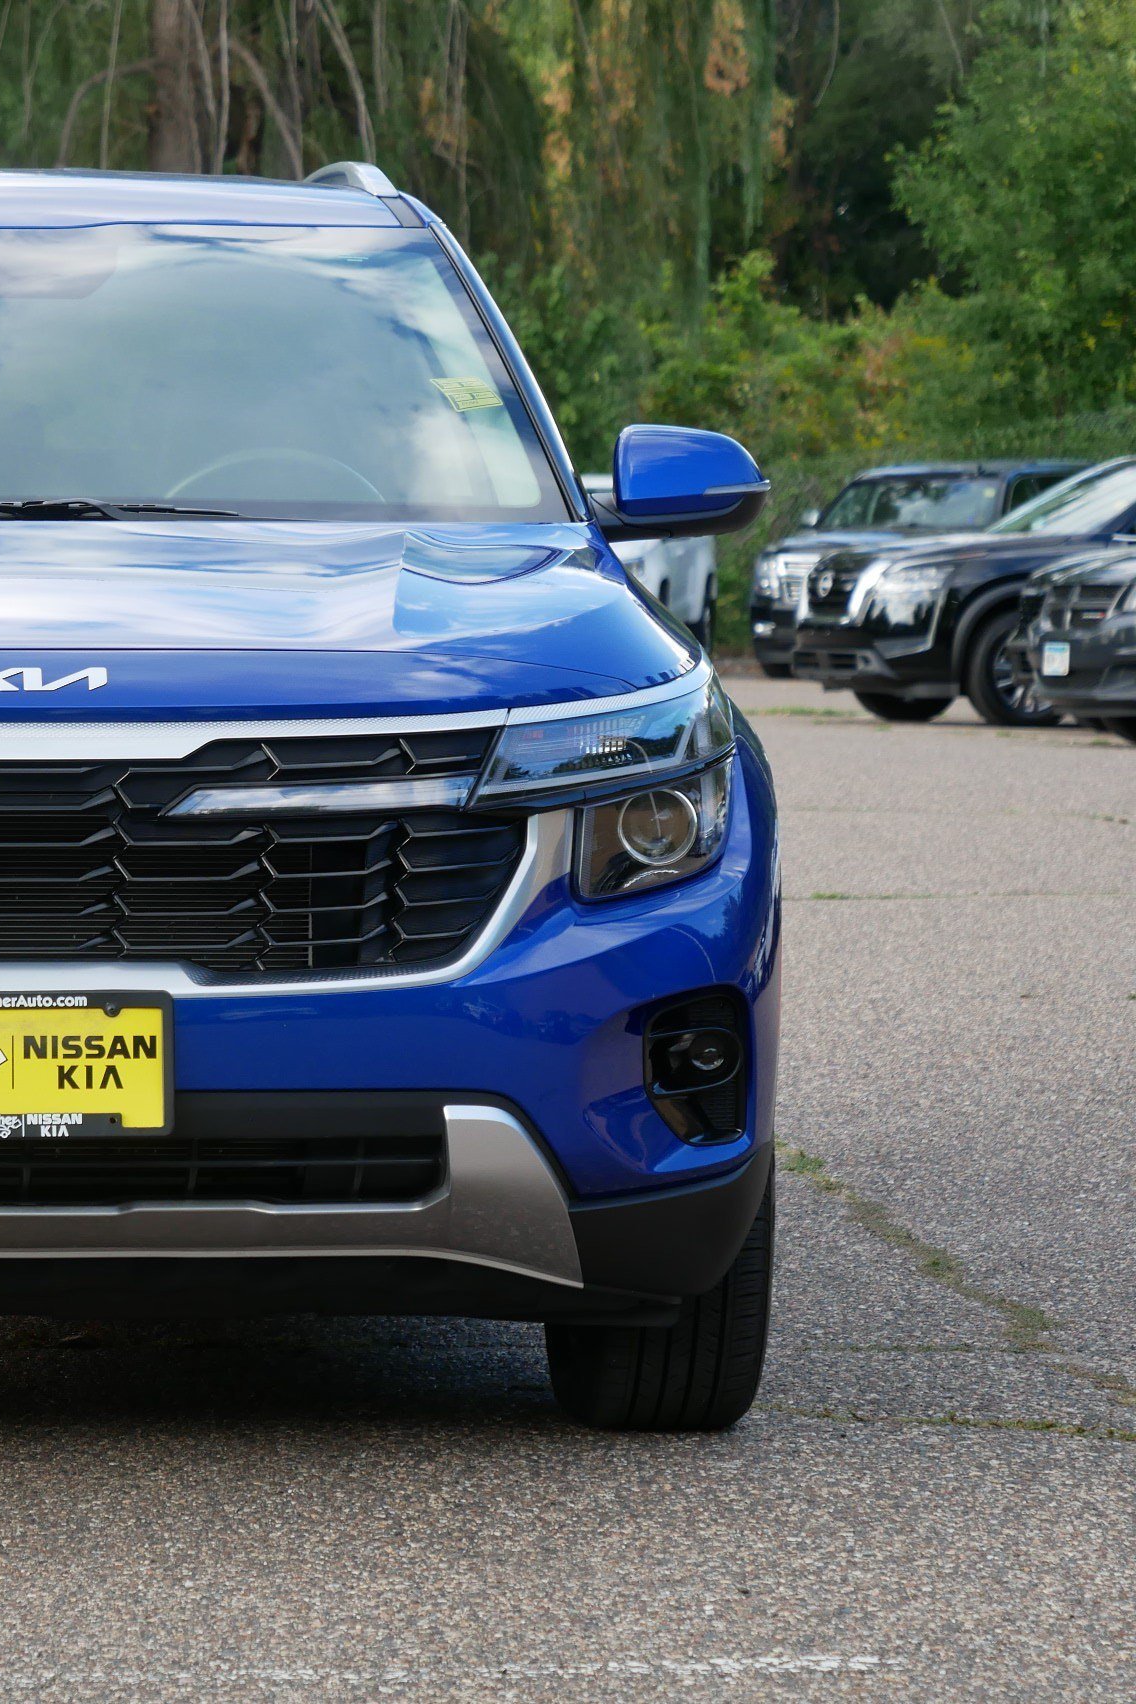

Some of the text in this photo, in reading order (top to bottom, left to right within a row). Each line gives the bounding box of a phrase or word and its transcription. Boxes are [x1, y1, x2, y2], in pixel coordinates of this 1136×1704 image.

[23, 1035, 157, 1060] NISSAN
[57, 1065, 124, 1089] KIA
[26, 1113, 83, 1125] NISSAN
[40, 1125, 70, 1137] KIA
